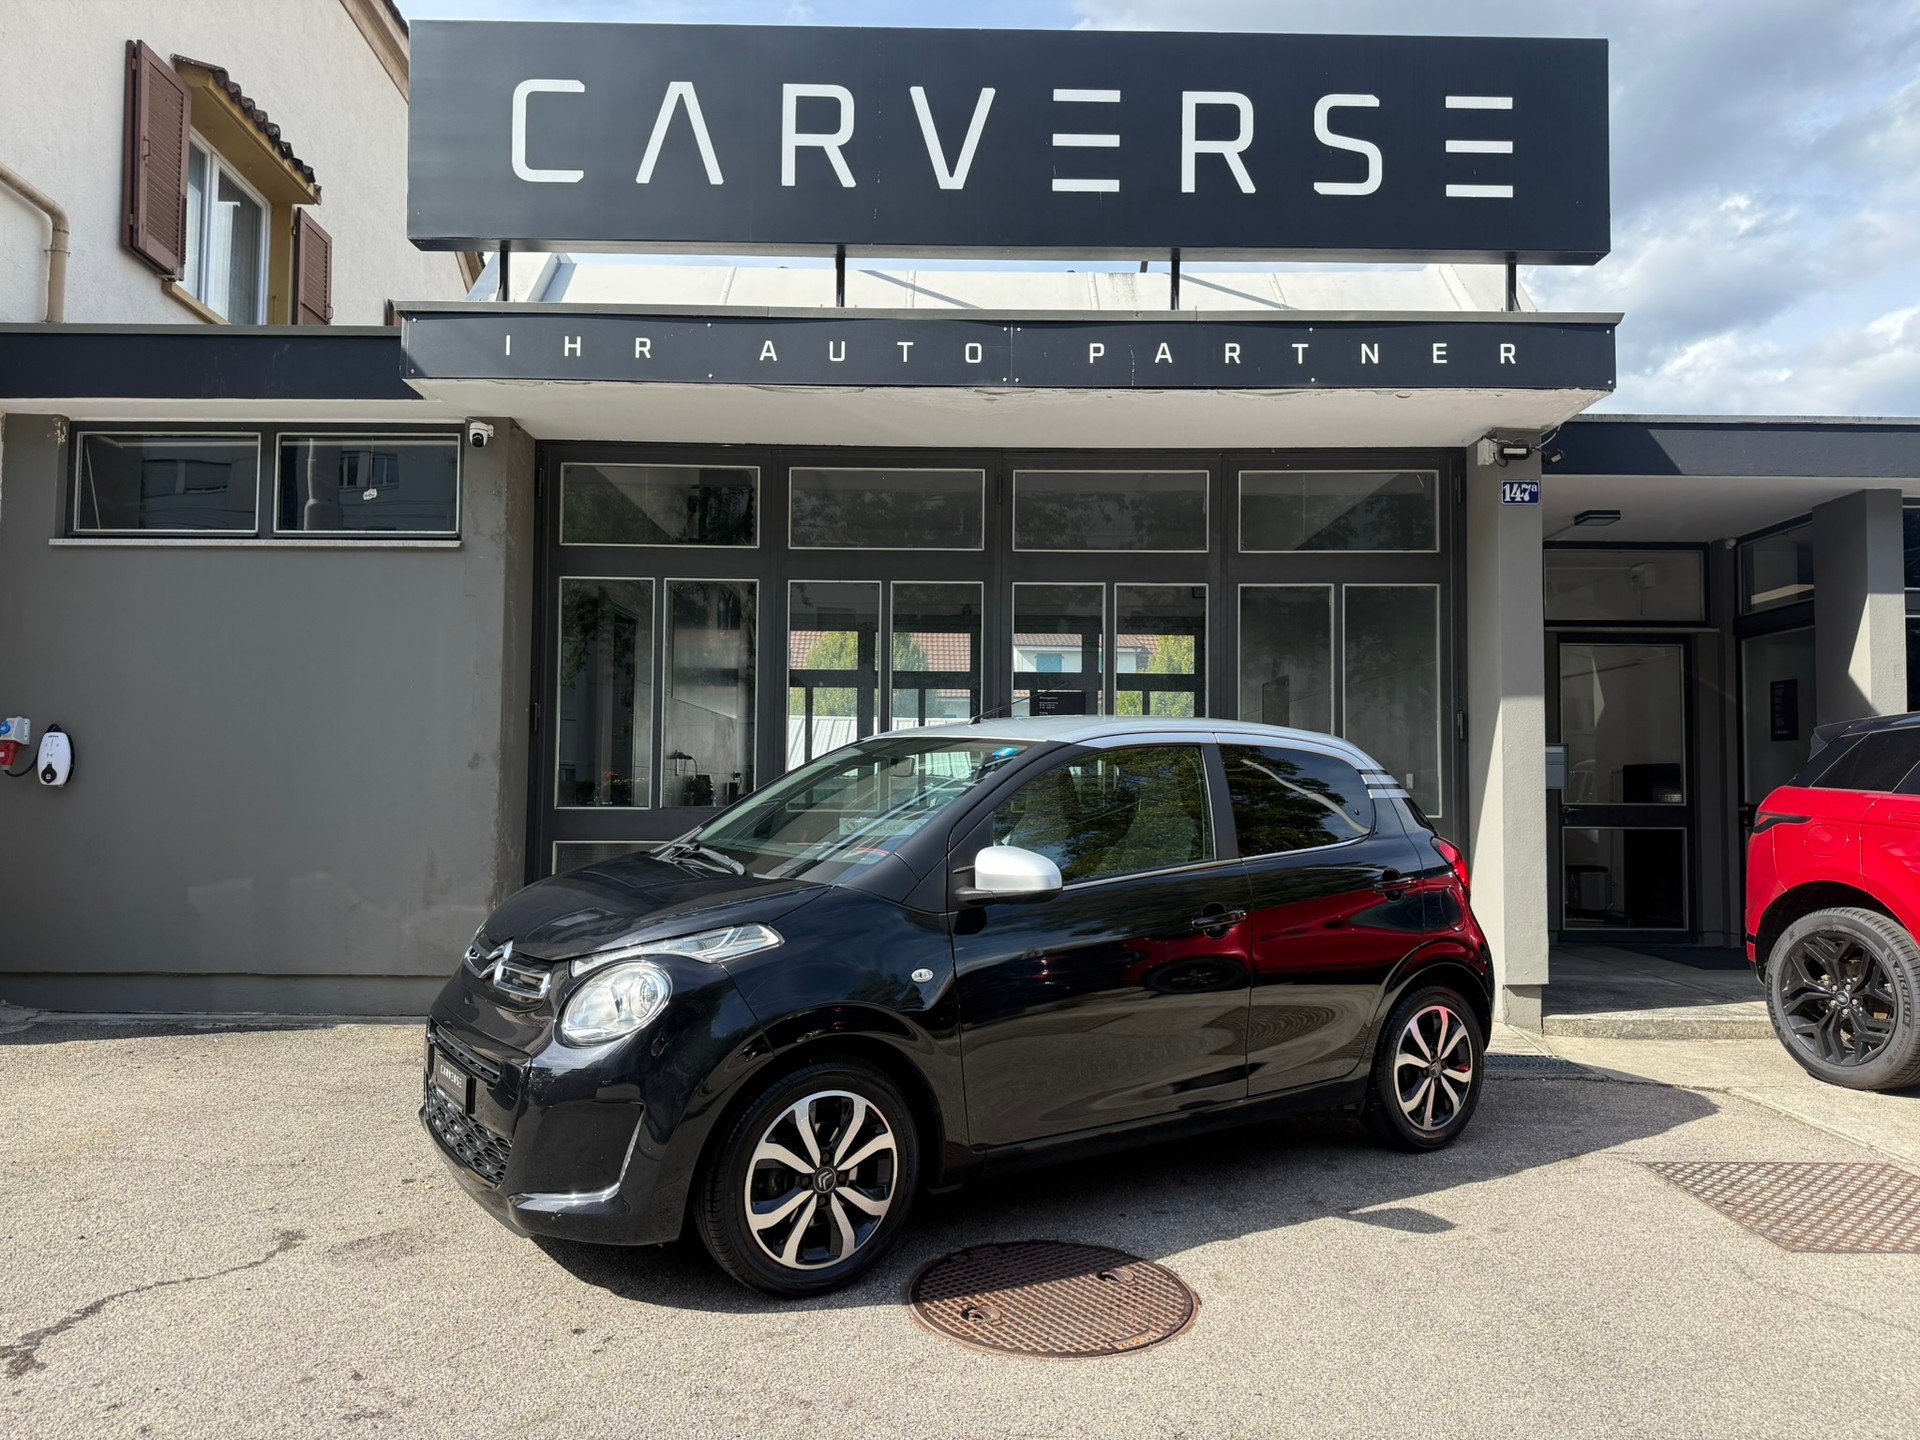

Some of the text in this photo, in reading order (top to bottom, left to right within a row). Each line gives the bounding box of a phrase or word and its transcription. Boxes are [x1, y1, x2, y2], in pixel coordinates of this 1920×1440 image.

[511, 78, 1514, 198] CARVERSE
[505, 334, 1516, 365] IHR AUTO PARTNER
[1503, 484, 1537, 501] 147a
